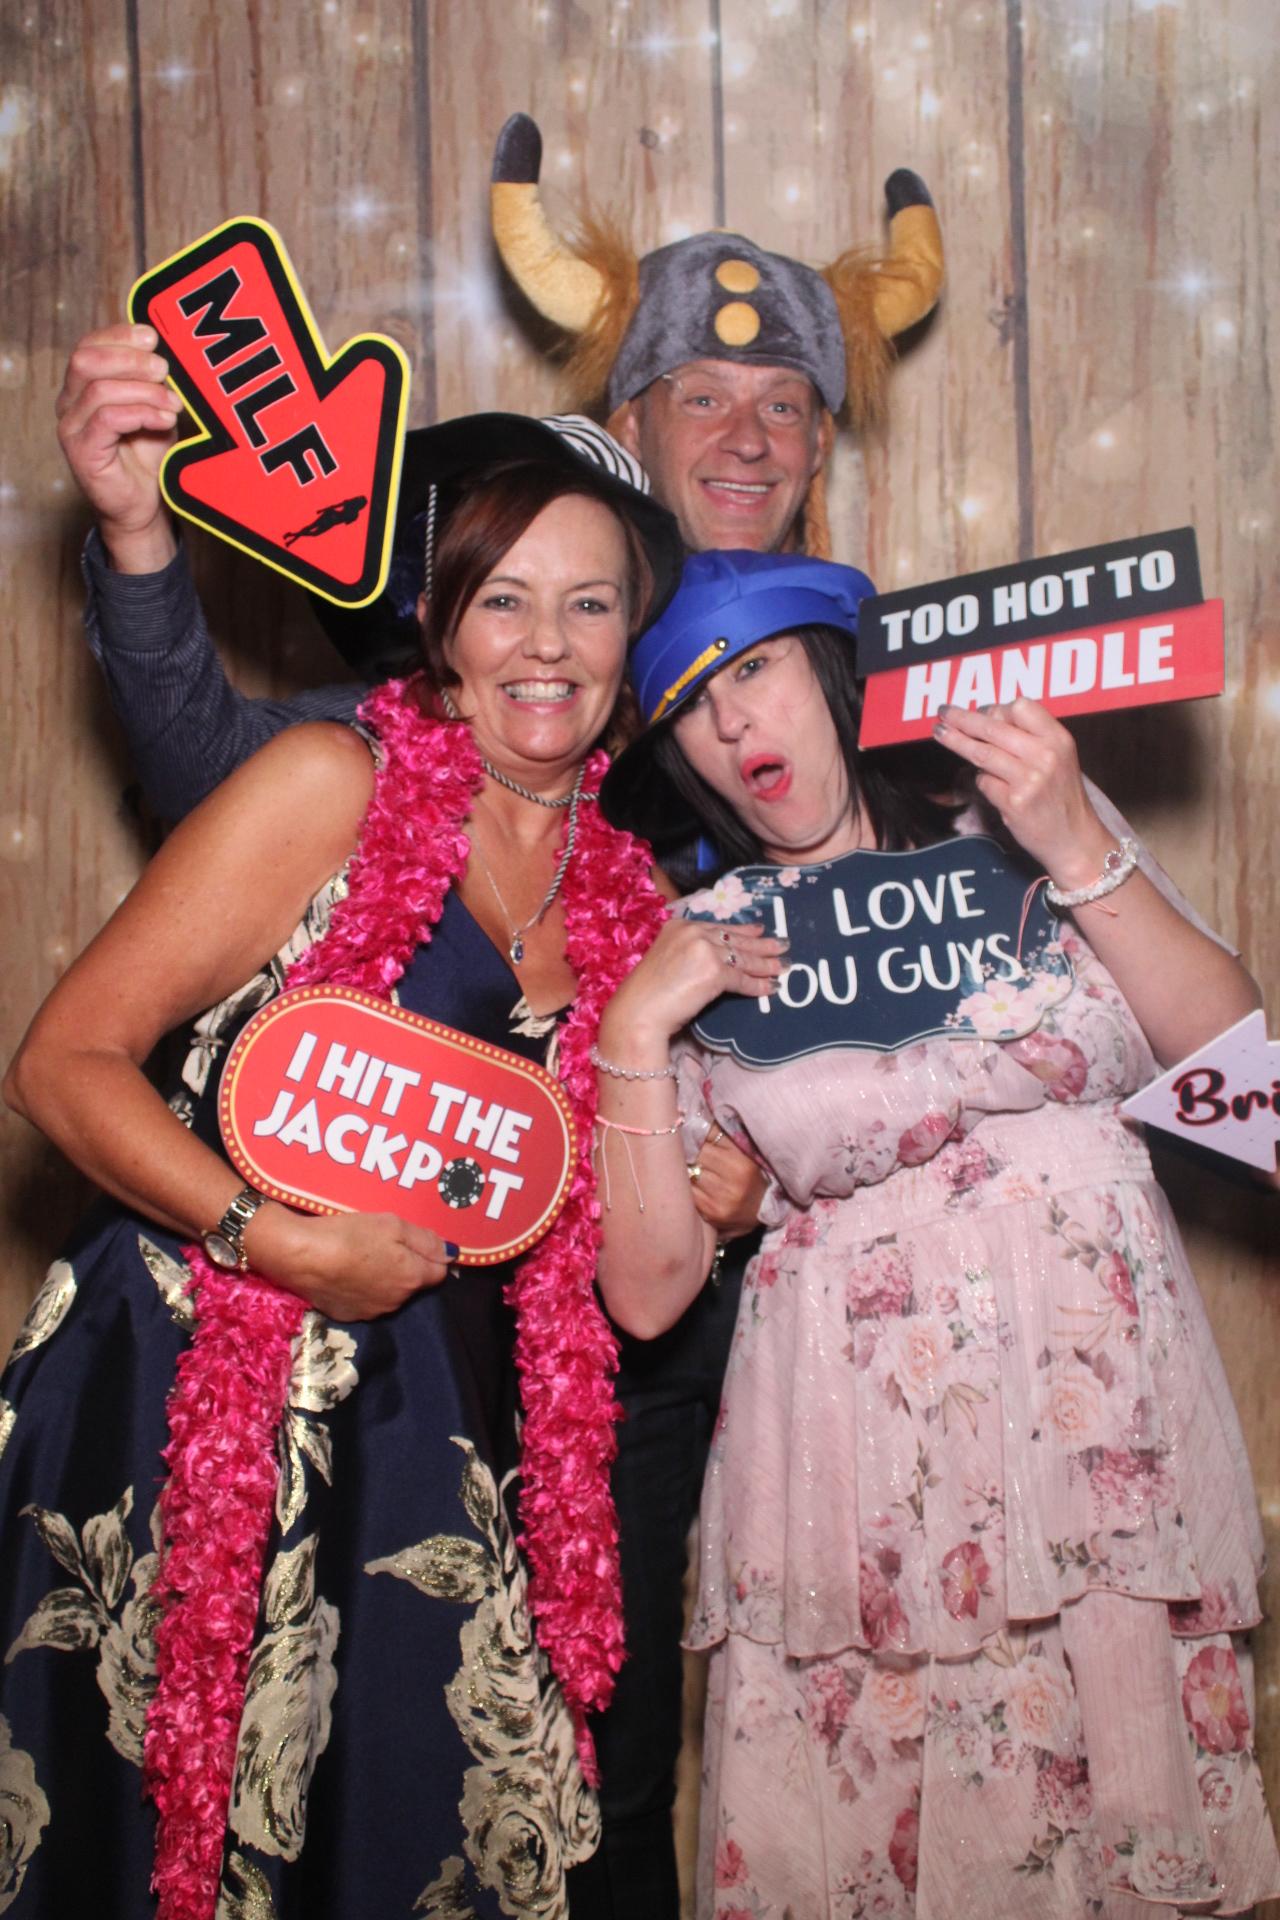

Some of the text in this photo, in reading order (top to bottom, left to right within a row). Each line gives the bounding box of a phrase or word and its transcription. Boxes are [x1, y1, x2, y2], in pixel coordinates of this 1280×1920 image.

[176, 265, 340, 487] MILF
[881, 550, 1176, 652] TOO HOT TO
[902, 624, 1174, 722] HANDLE
[773, 869, 985, 938] I LOVE
[758, 932, 1024, 1014] OU GUYS
[285, 1031, 533, 1164] I HIT THE
